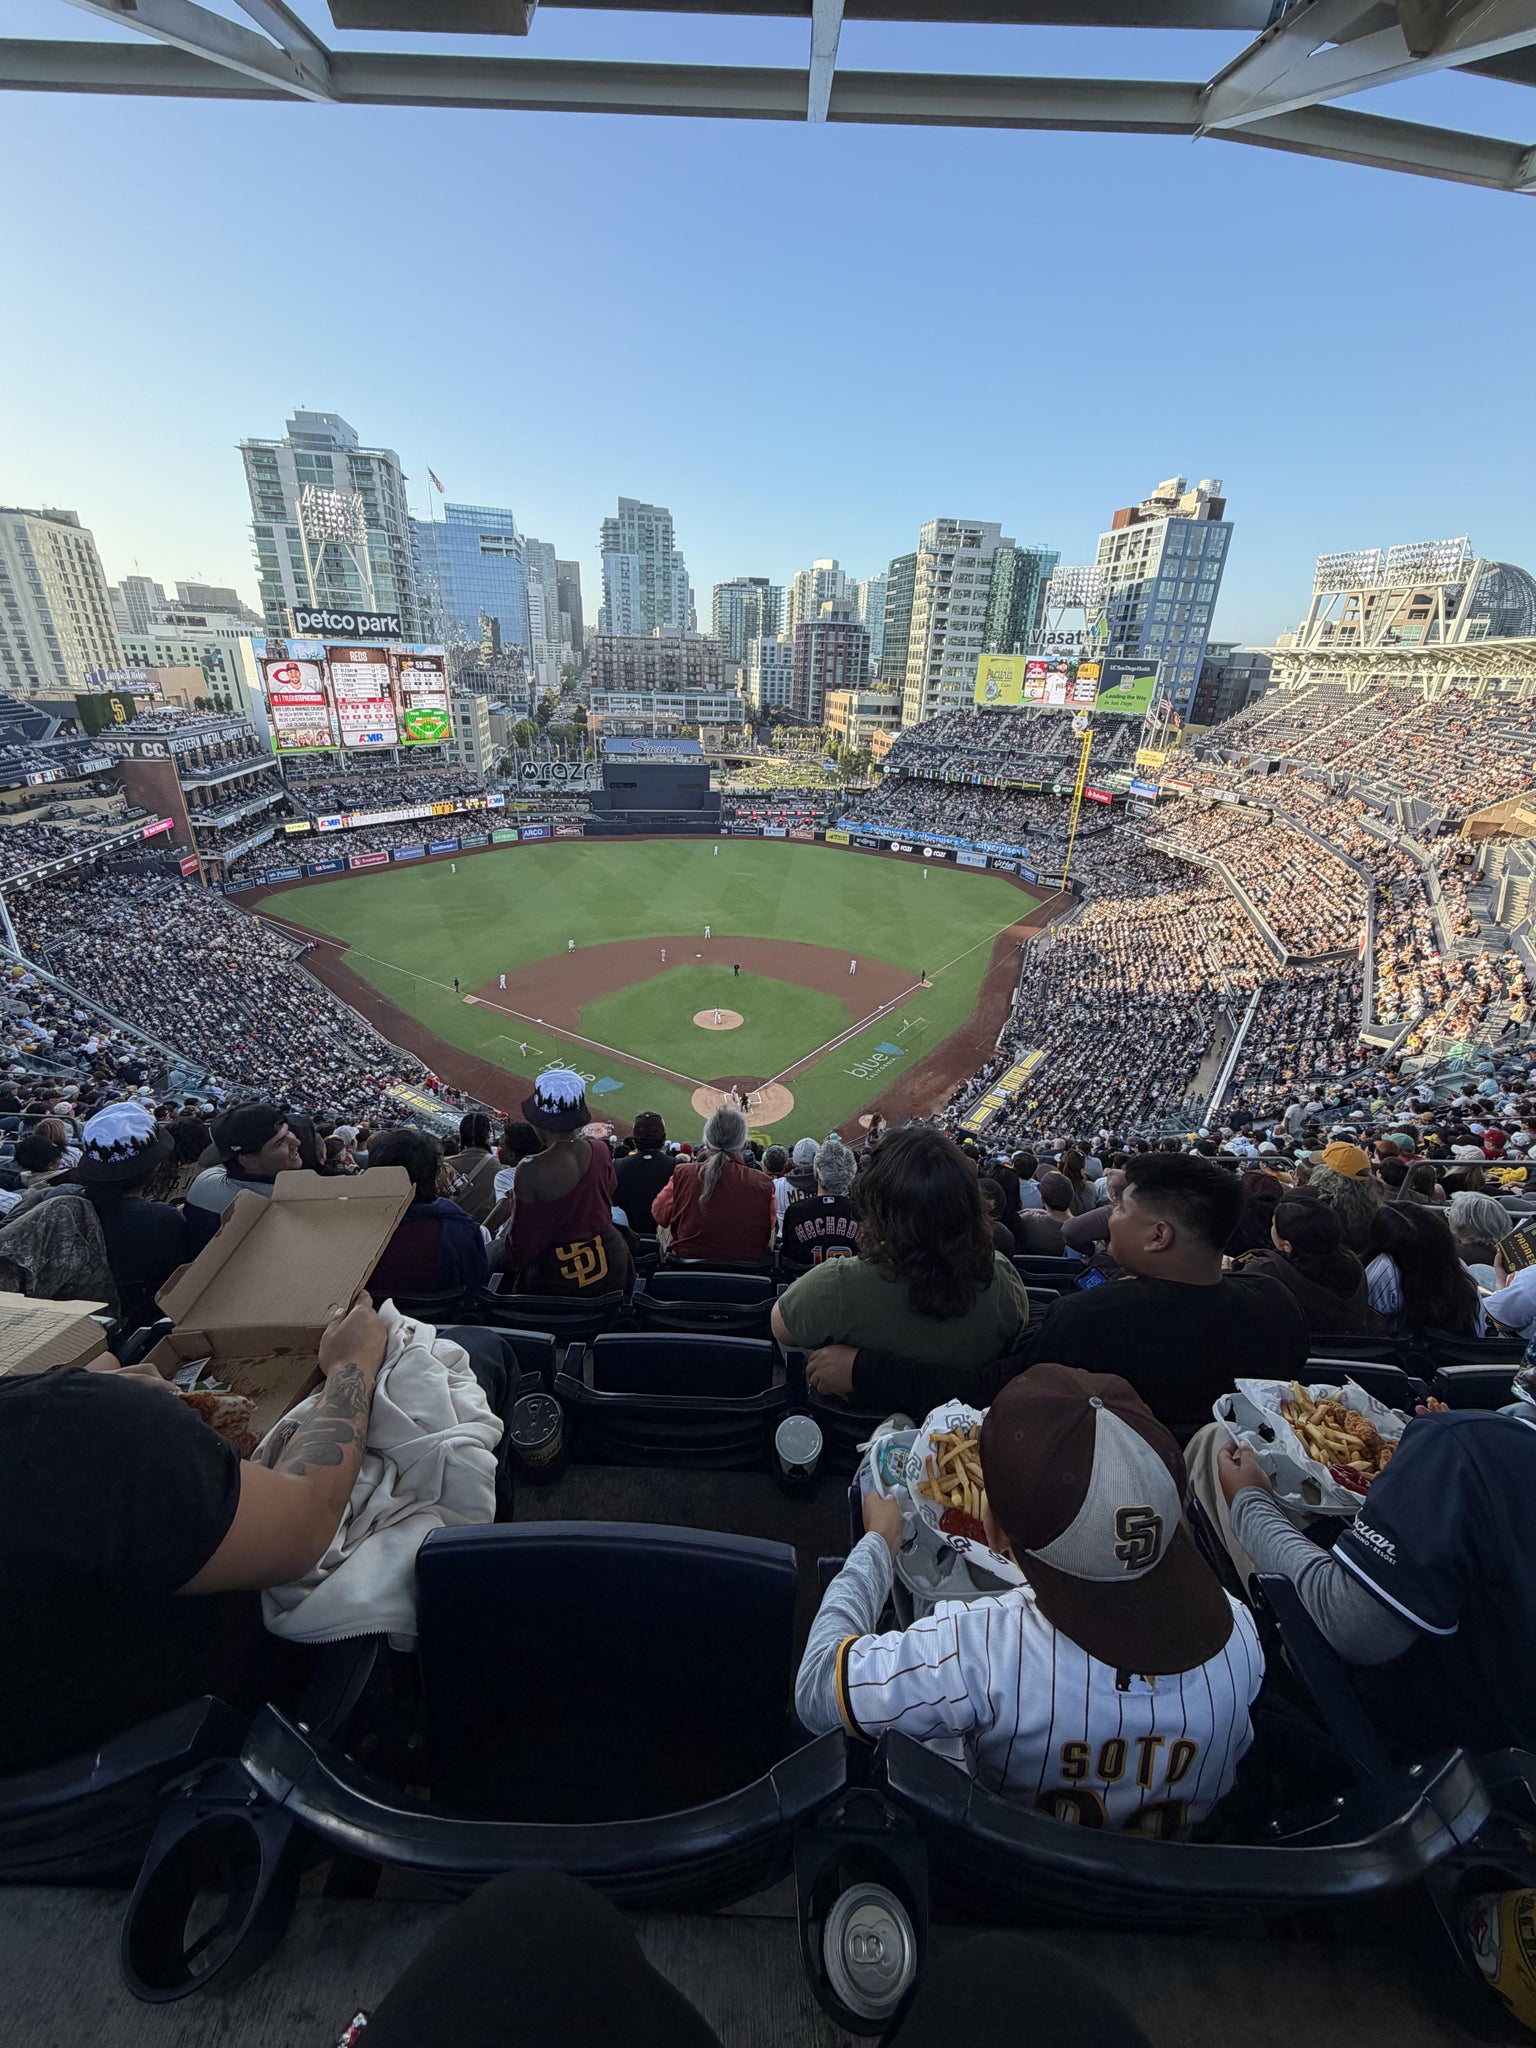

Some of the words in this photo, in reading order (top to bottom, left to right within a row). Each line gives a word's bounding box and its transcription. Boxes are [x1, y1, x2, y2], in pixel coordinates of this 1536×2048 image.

[296, 610, 354, 632] petco
[357, 615, 399, 635] park
[1032, 629, 1083, 645] Viasat
[349, 651, 368, 662] REDS
[169, 736, 200, 753] WESTERN
[201, 732, 221, 745] METAL
[222, 727, 243, 742] SUPPLY
[359, 733, 384, 743] AMR
[140, 742, 171, 758] CO.
[630, 738, 681, 755] Sycuan
[541, 763, 595, 780] razr
[320, 818, 341, 828] AMR
[523, 828, 543, 837] ARCO
[431, 843, 455, 851] Southwest
[933, 850, 947, 858] razr
[255, 877, 266, 885] 342
[843, 1053, 889, 1078] blue
[1113, 1504, 1164, 1571] SD
[1353, 1512, 1396, 1557] cuan
[1372, 1546, 1398, 1566] RESORT
[1059, 1735, 1200, 1790] SOTO
